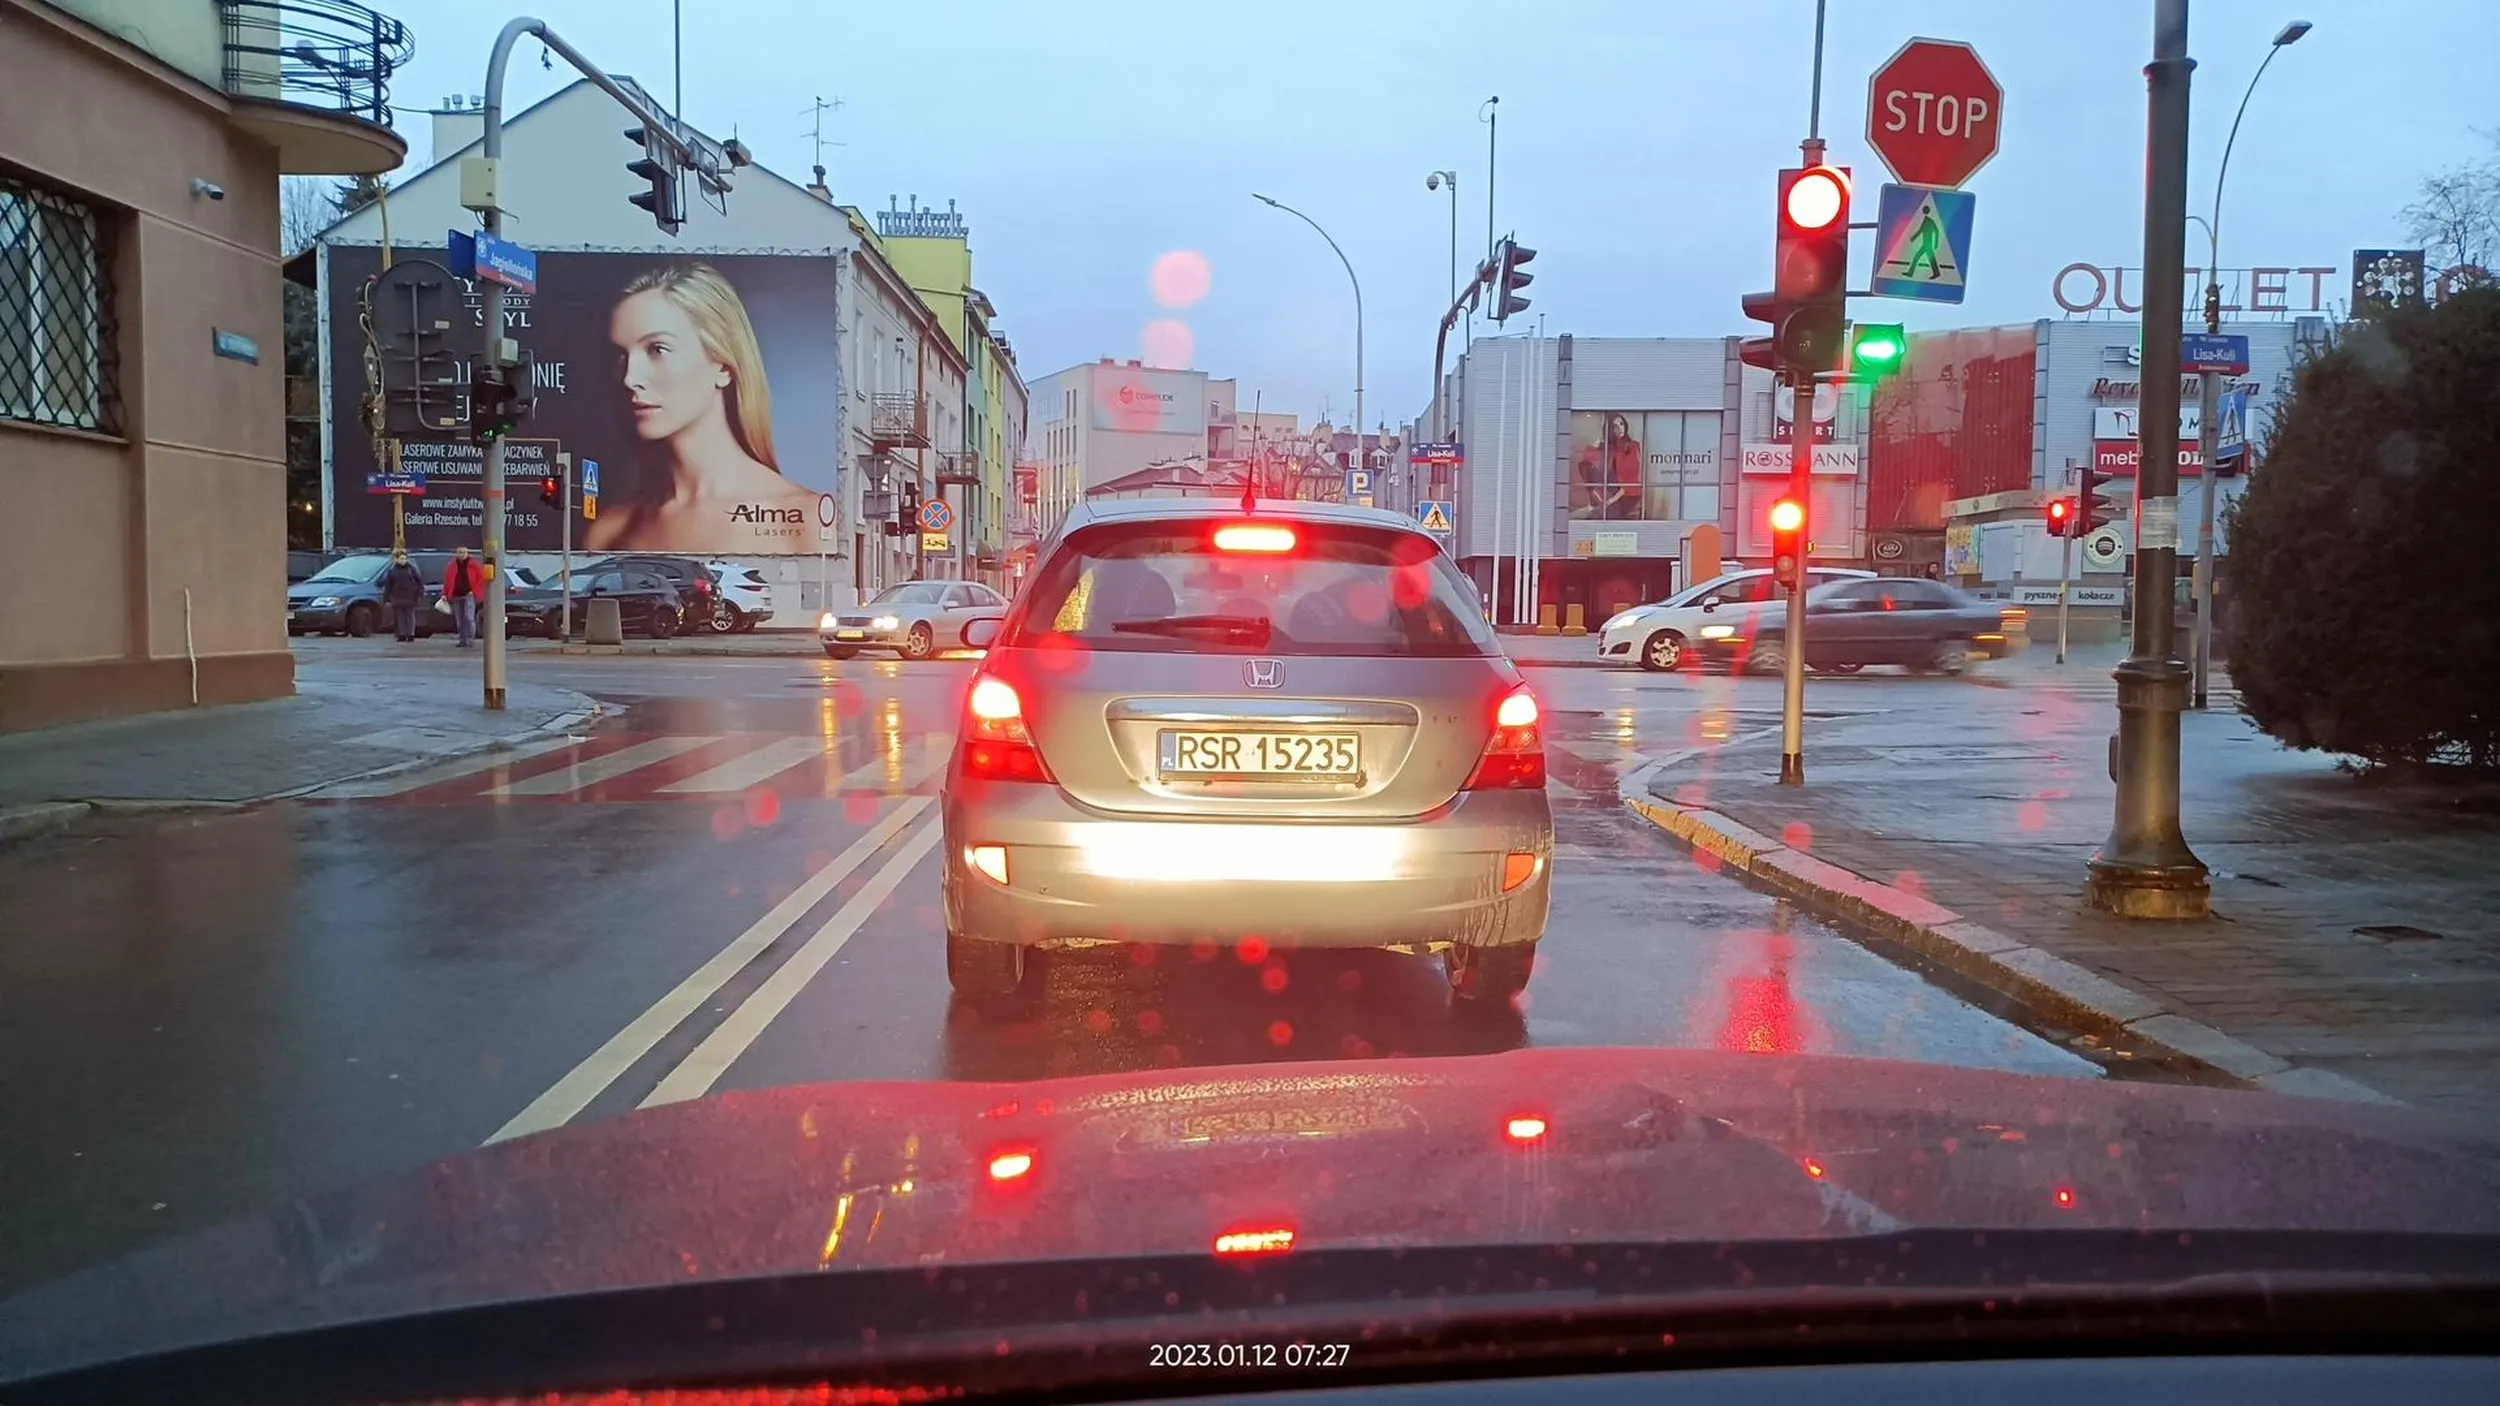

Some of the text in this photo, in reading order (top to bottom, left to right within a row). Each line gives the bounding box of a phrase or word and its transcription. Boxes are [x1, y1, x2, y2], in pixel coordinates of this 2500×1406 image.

[1885, 90, 1988, 138] STOP
[475, 308, 532, 328] SYL
[2193, 347, 2236, 361] Lisa-Kuli
[1650, 450, 1711, 465] monnari
[1745, 451, 1856, 467] ROSSANN
[405, 512, 433, 525] Galeria
[526, 514, 538, 527] 55
[724, 504, 804, 523] Alma
[754, 527, 802, 537] Lasers
[2024, 591, 2058, 601] pyszne
[1178, 736, 1354, 771] RSR 15235
[1161, 757, 1174, 767] PL
